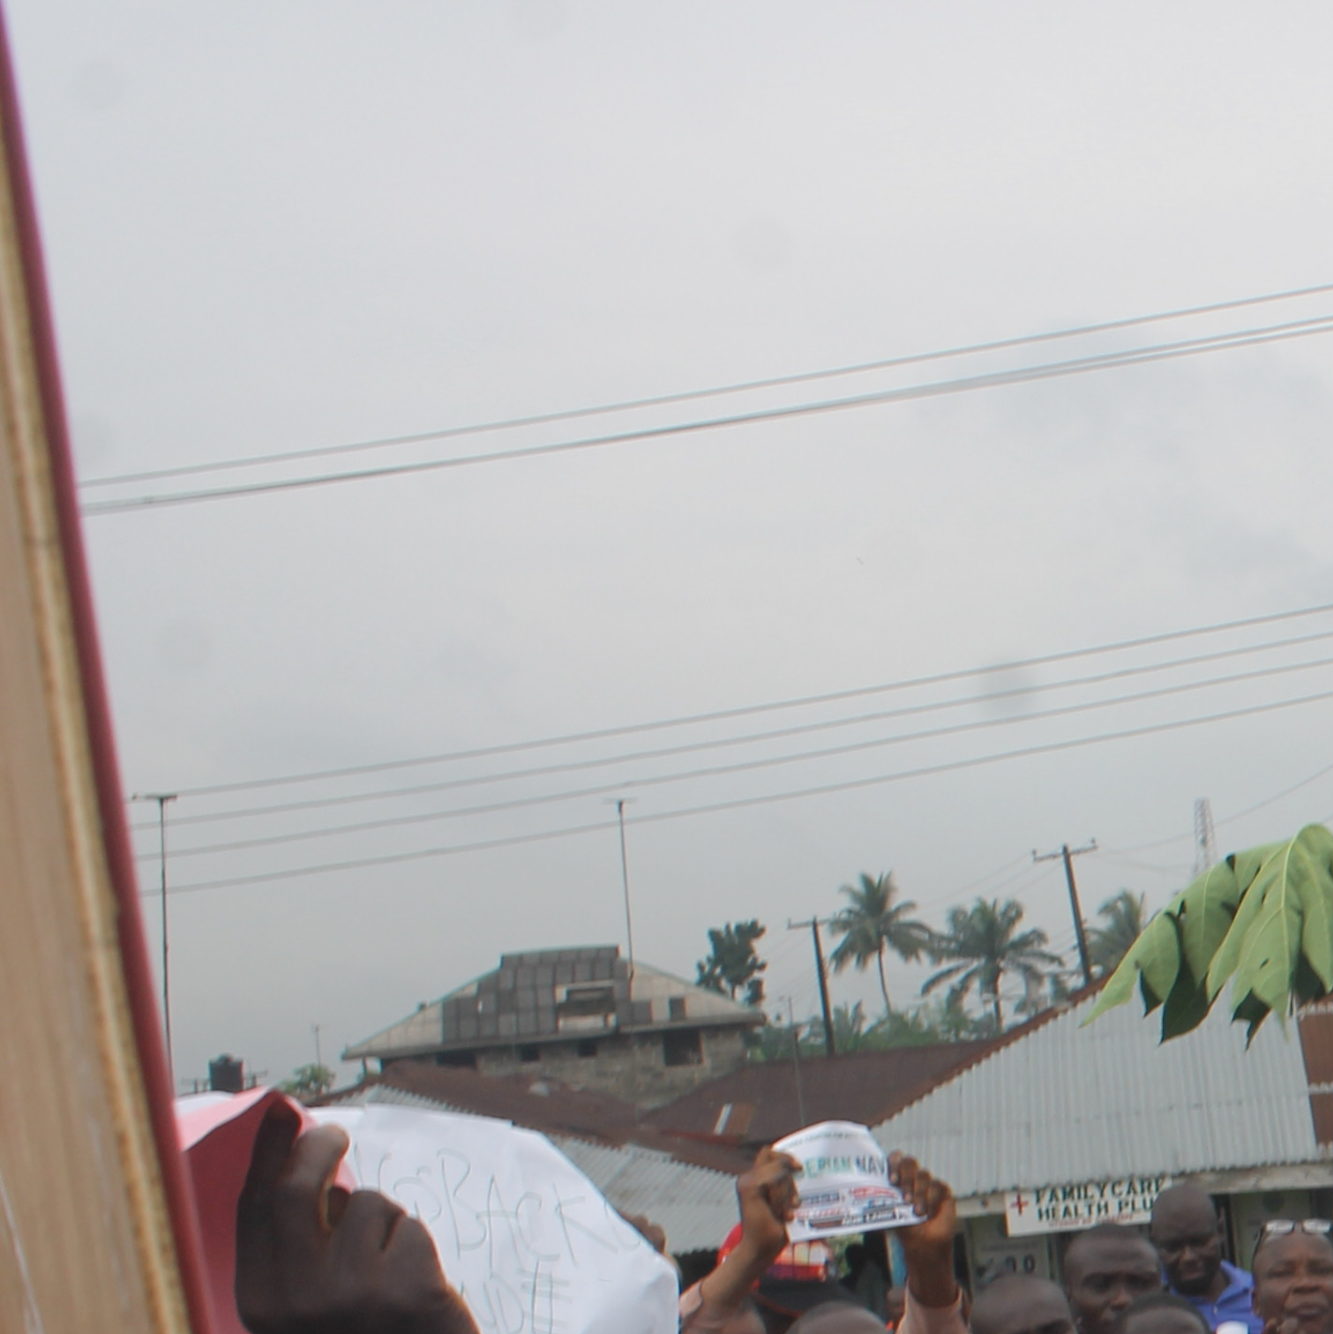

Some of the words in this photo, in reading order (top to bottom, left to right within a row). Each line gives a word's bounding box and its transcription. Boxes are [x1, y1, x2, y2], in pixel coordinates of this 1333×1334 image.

[855, 1154, 886, 1172] NAV
[1037, 1197, 1110, 1221] HEALTH
[1117, 1193, 1155, 1213] PLU
